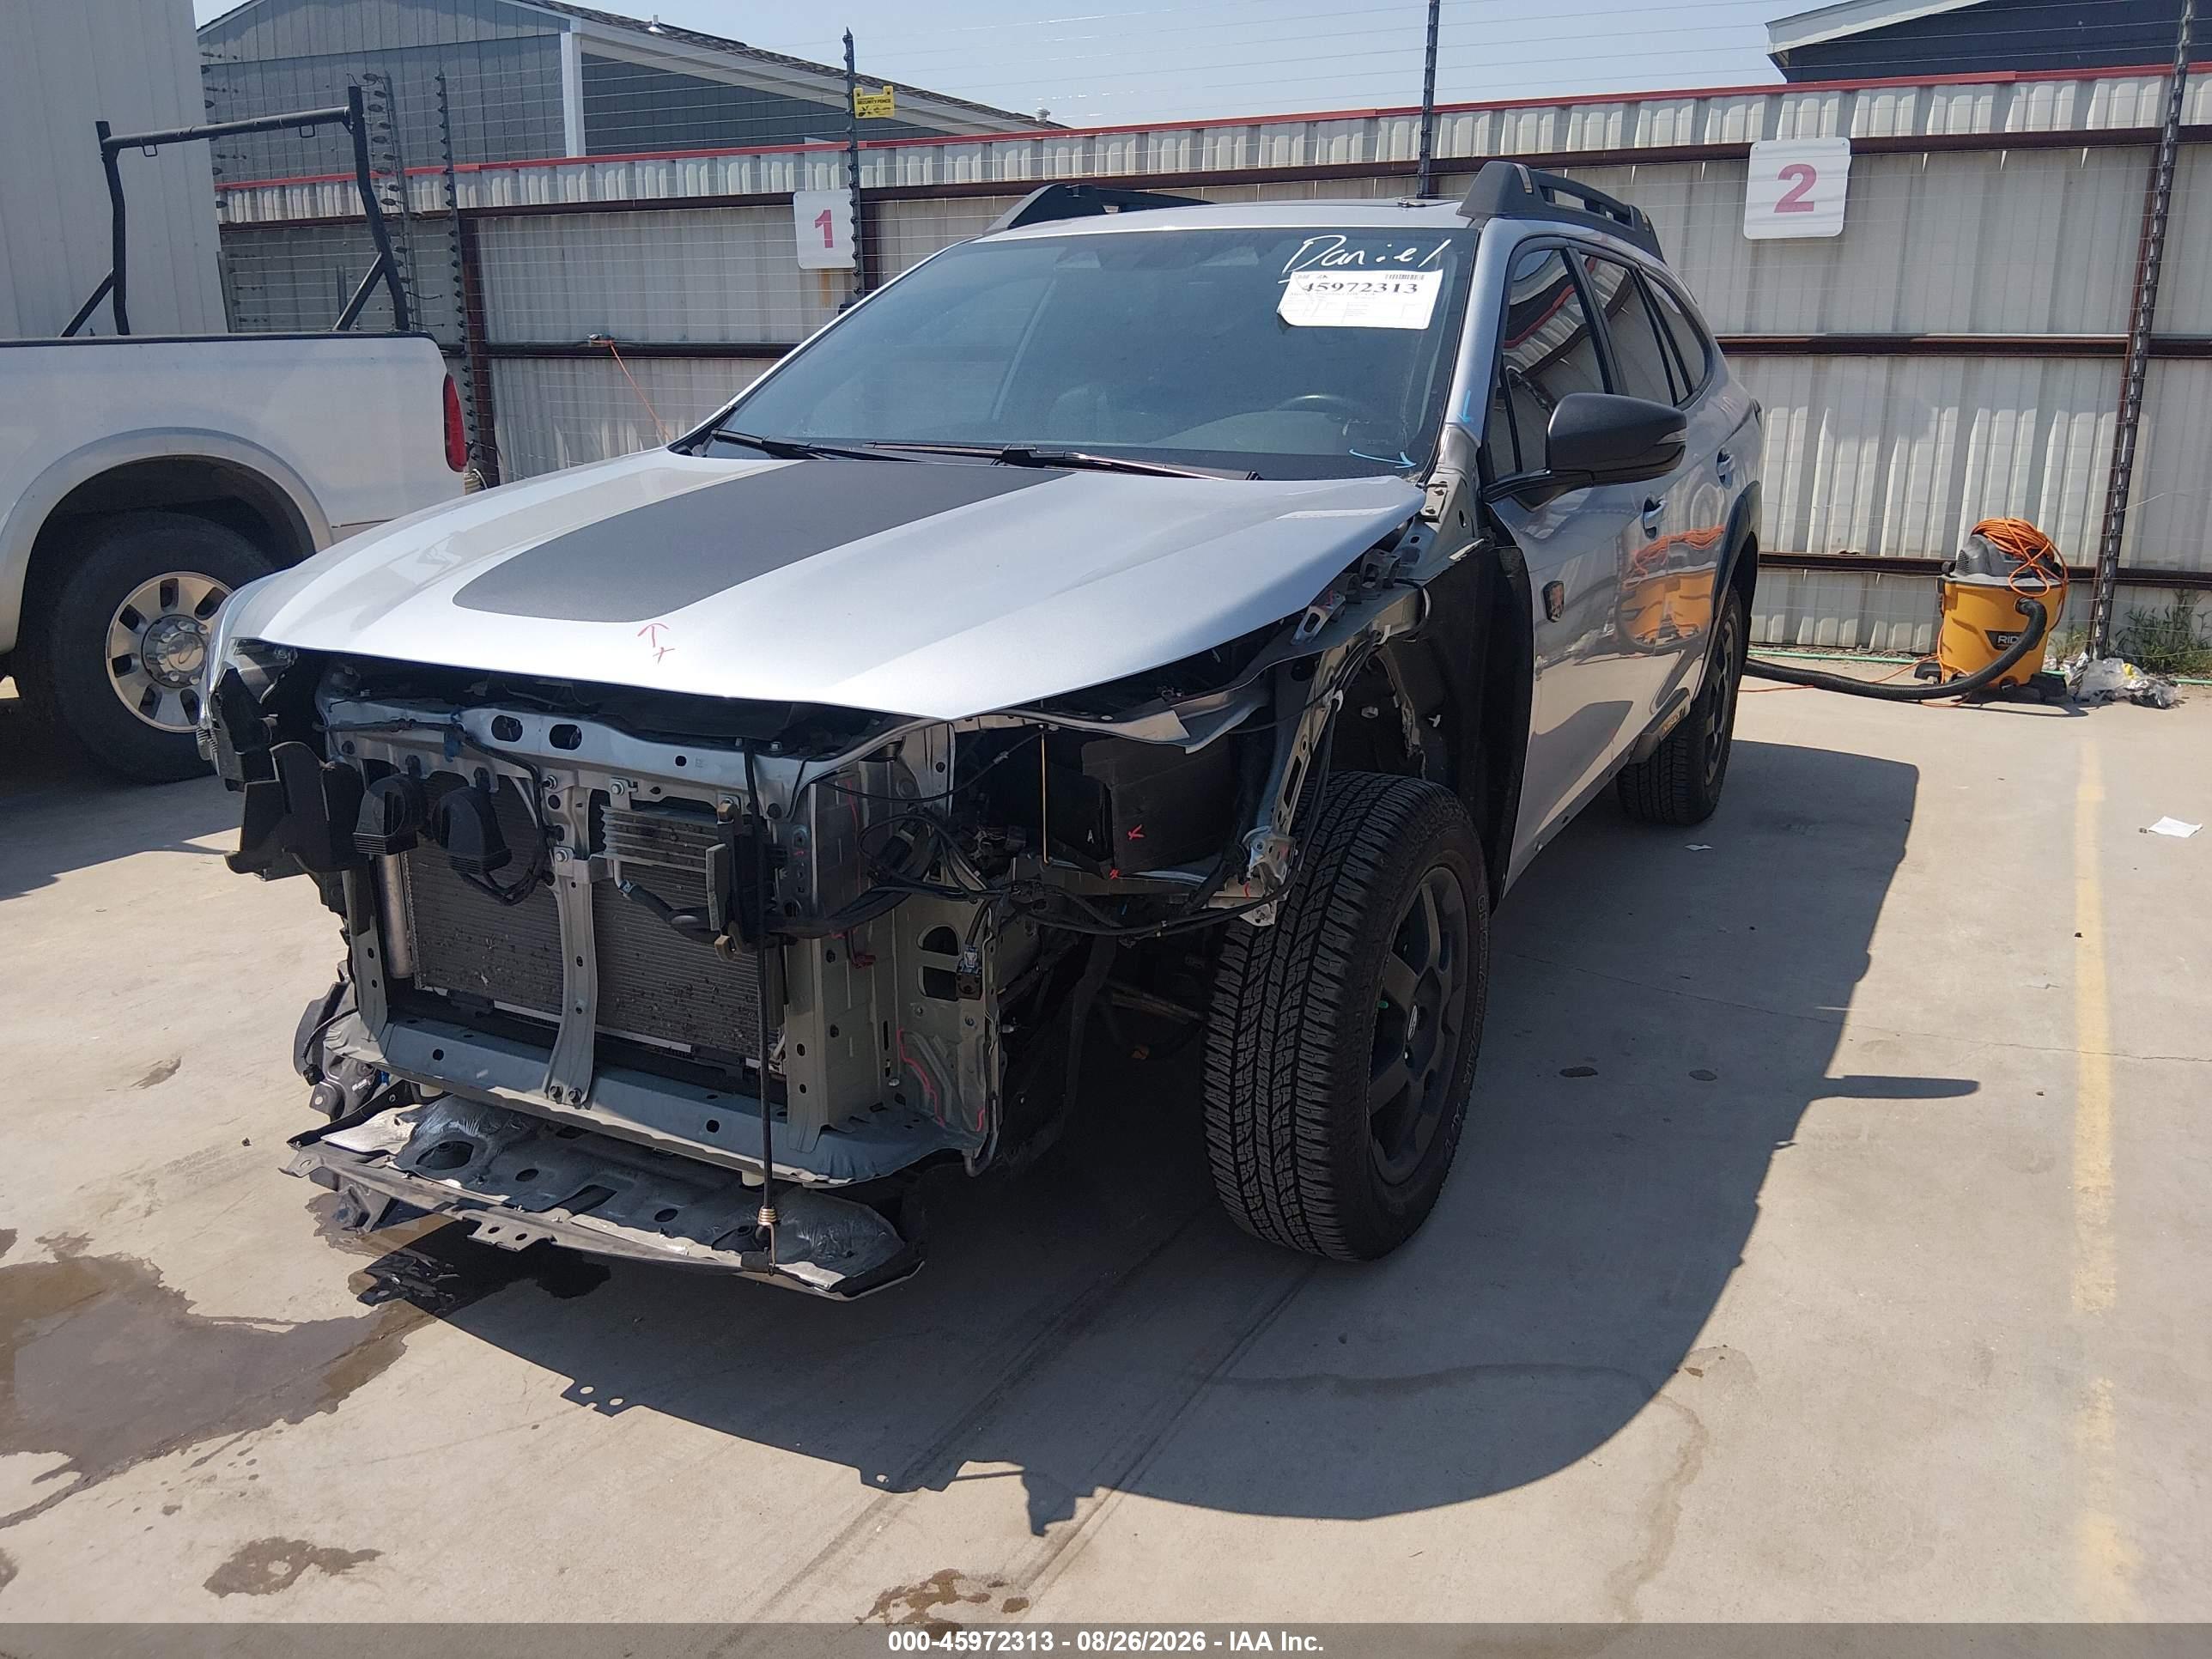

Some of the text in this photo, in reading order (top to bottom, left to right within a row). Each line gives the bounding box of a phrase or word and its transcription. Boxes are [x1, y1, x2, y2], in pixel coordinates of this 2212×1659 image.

[1774, 163, 1817, 214] 2
[814, 210, 834, 248] 1
[1278, 234, 1451, 282] Daniel
[1304, 281, 1418, 294] 45972313
[1997, 635, 2021, 644] RID
